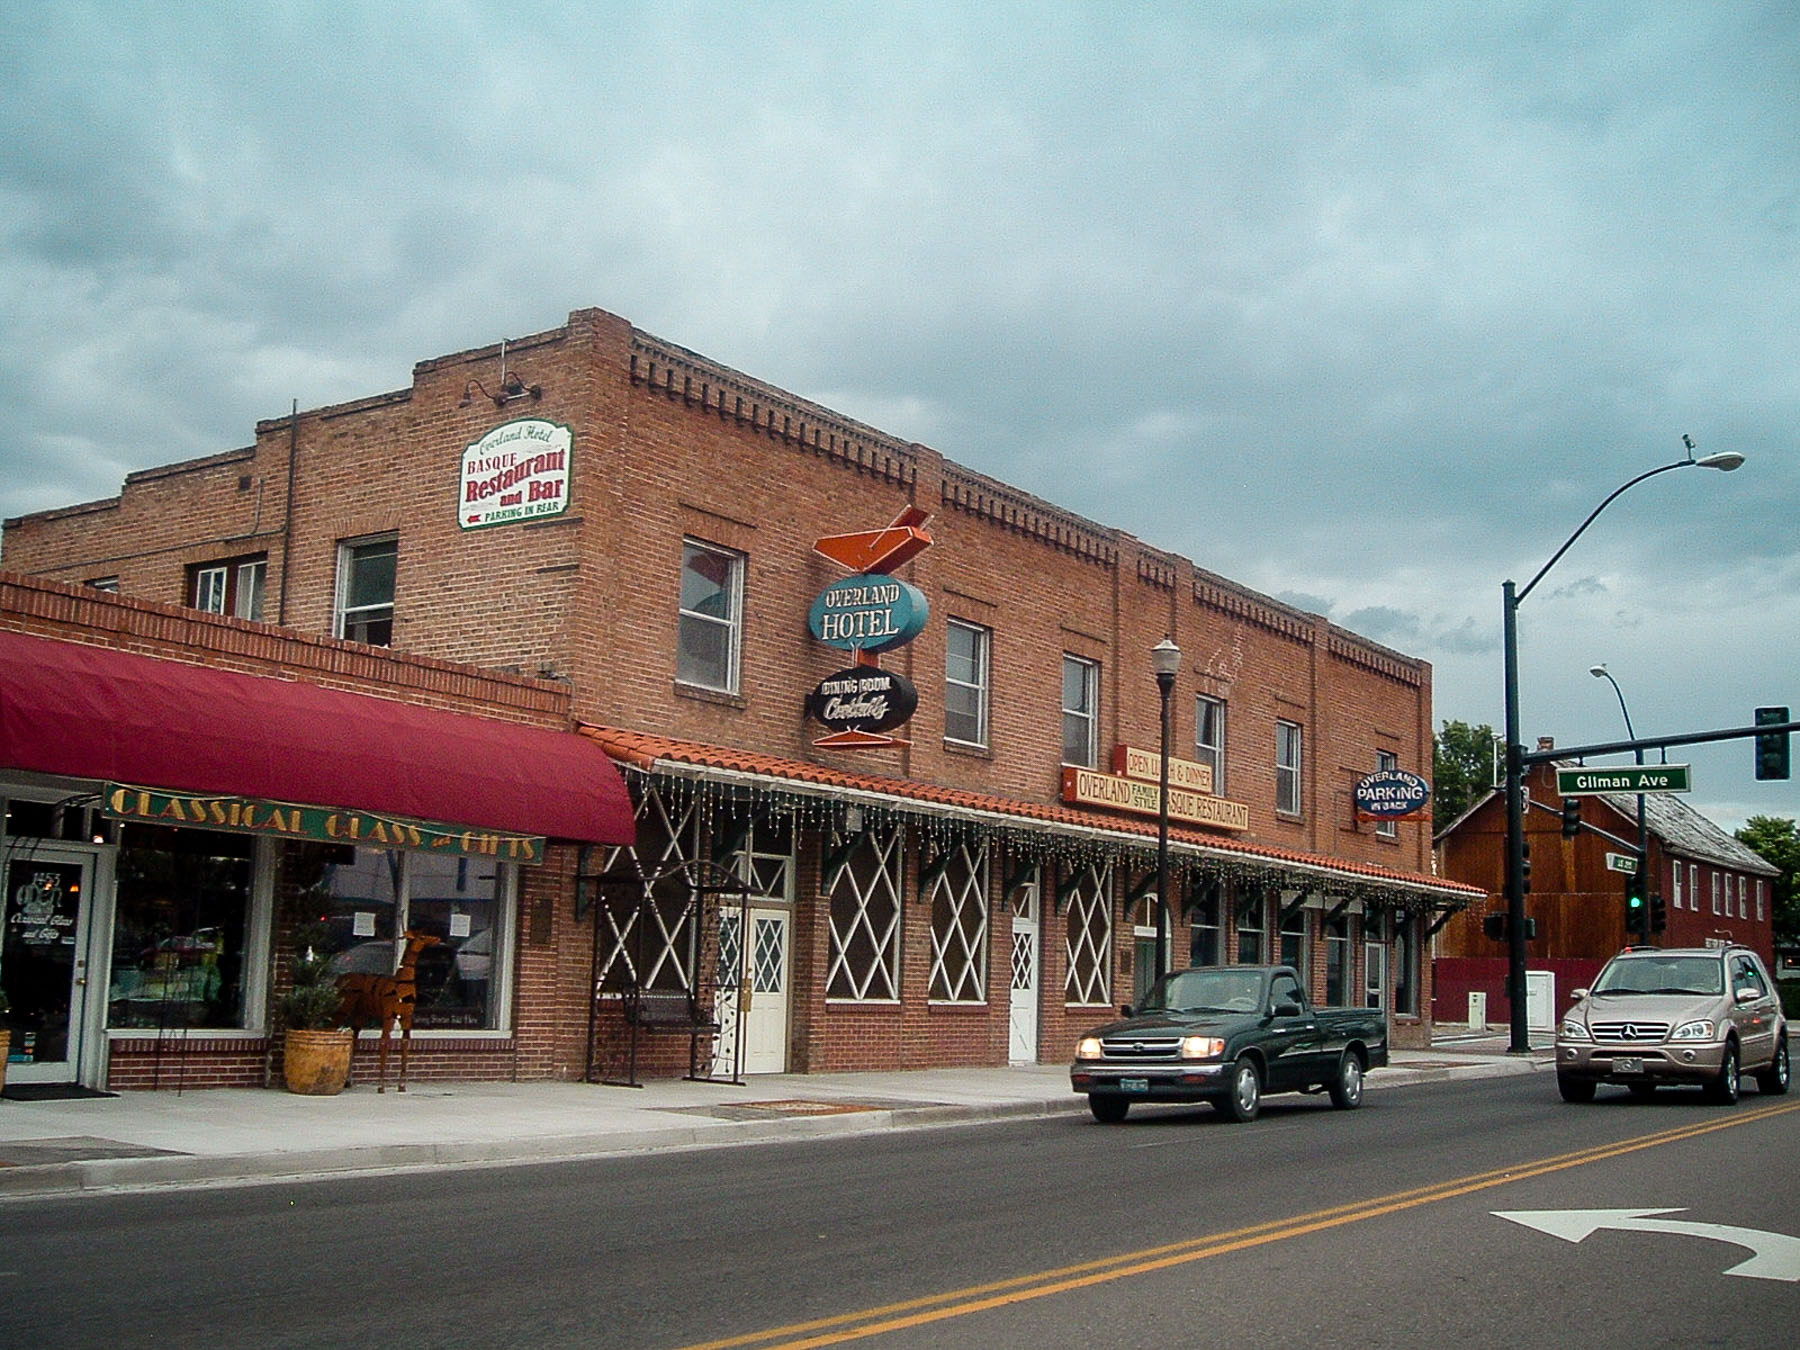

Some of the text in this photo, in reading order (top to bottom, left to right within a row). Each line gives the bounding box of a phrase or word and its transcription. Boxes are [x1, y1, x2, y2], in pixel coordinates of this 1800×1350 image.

[523, 425, 553, 443] Hotel
[467, 452, 517, 474] BASQUE
[465, 448, 565, 502] Restaurant
[500, 479, 564, 506] and Bar
[485, 501, 559, 522] PARKING IN REAR
[826, 584, 900, 608] OVERLAND
[822, 609, 899, 640] HOTEL
[821, 677, 891, 695] DINING ROOM
[1129, 753, 1149, 774] OPEN
[1186, 766, 1211, 787] DINNER
[1360, 771, 1418, 788] OVERLAND
[1079, 773, 1131, 804] OVERLAND
[1132, 783, 1159, 799] FAMILY
[1576, 774, 1669, 789] Gilman Ave
[1134, 795, 1158, 810] STYLE
[1357, 787, 1423, 800] PARKING
[110, 788, 309, 836] CLASSICAL
[324, 814, 423, 847] GLASS
[1196, 797, 1247, 827] RESTAURANT
